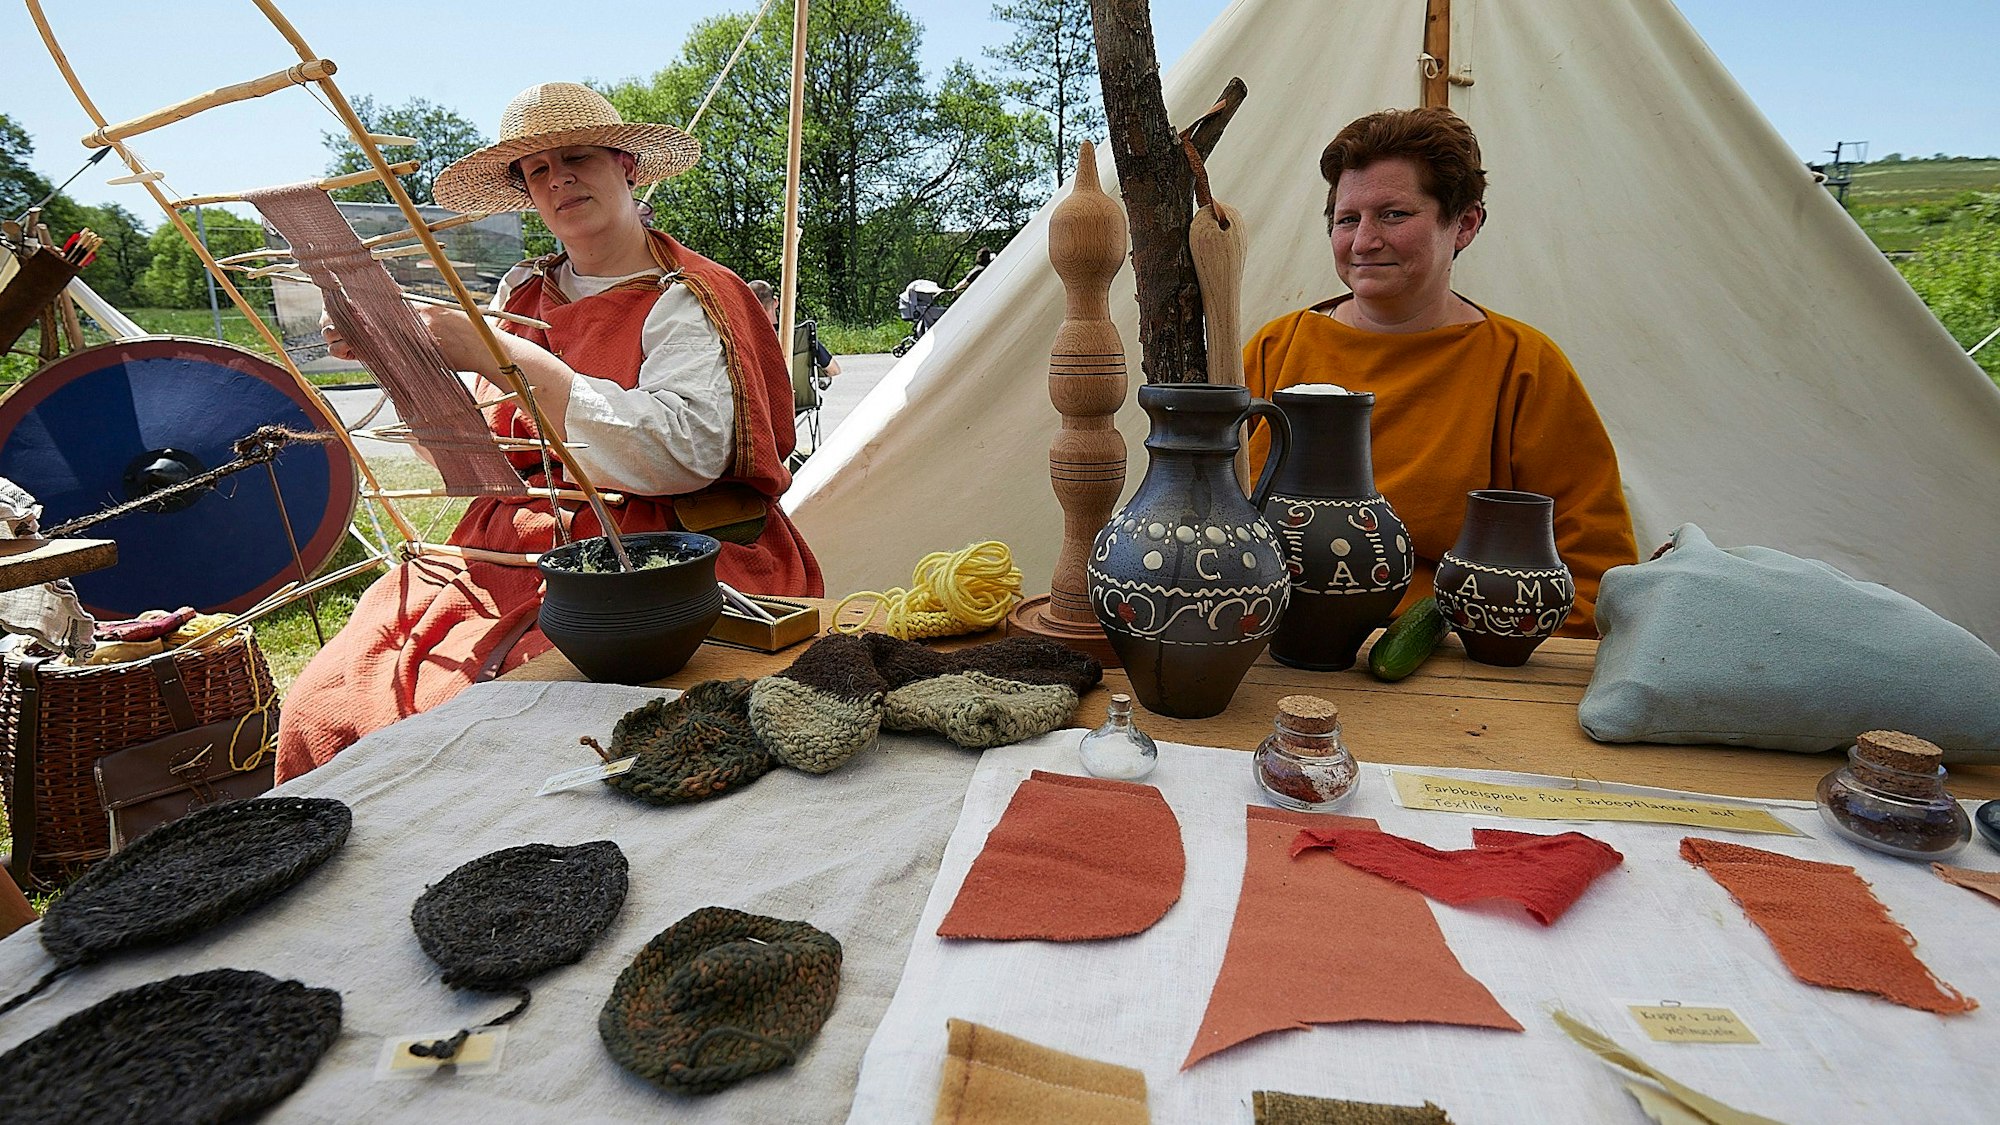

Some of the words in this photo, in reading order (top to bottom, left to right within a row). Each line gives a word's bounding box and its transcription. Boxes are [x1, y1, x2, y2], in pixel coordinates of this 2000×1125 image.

[1196, 548, 1221, 580] C
[1328, 561, 1360, 587] A
[1425, 783, 1530, 802] Farbbeispiele
[1538, 792, 1565, 803] für
[1576, 796, 1700, 815] Färbepflanzen
[1709, 808, 1738, 819] auf
[1433, 797, 1504, 813] Textilien
